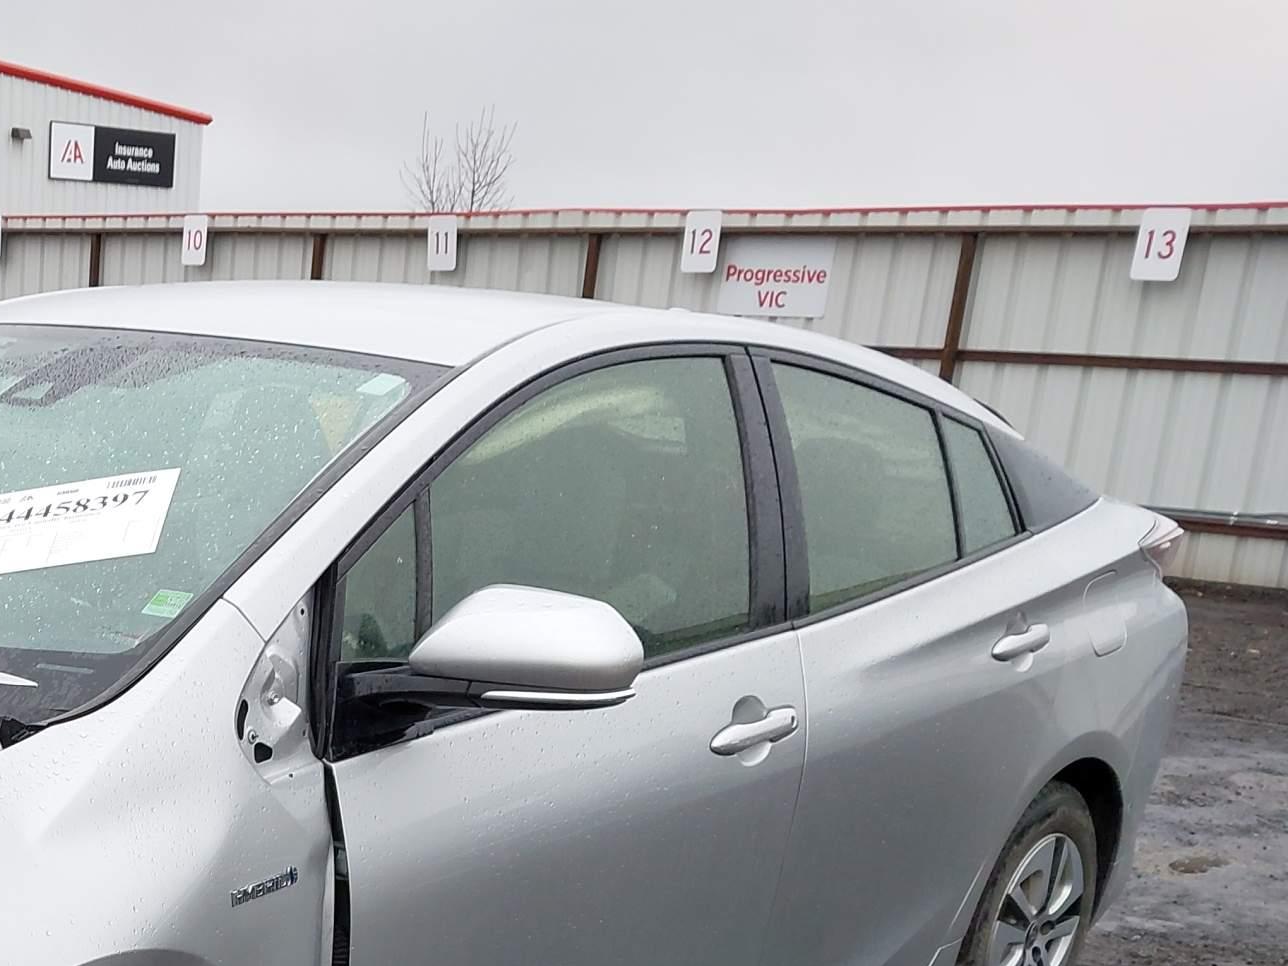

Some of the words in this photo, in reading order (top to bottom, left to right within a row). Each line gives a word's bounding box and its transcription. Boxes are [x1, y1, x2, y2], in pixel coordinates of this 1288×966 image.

[114, 142, 153, 159] Insurance
[106, 155, 126, 170] Auto
[126, 158, 160, 174] Auctions
[187, 230, 203, 250] 10
[435, 231, 449, 254] 11
[690, 228, 713, 255] 12
[1144, 229, 1177, 260] 13
[725, 264, 827, 286] Progressive
[757, 290, 787, 308] VIC
